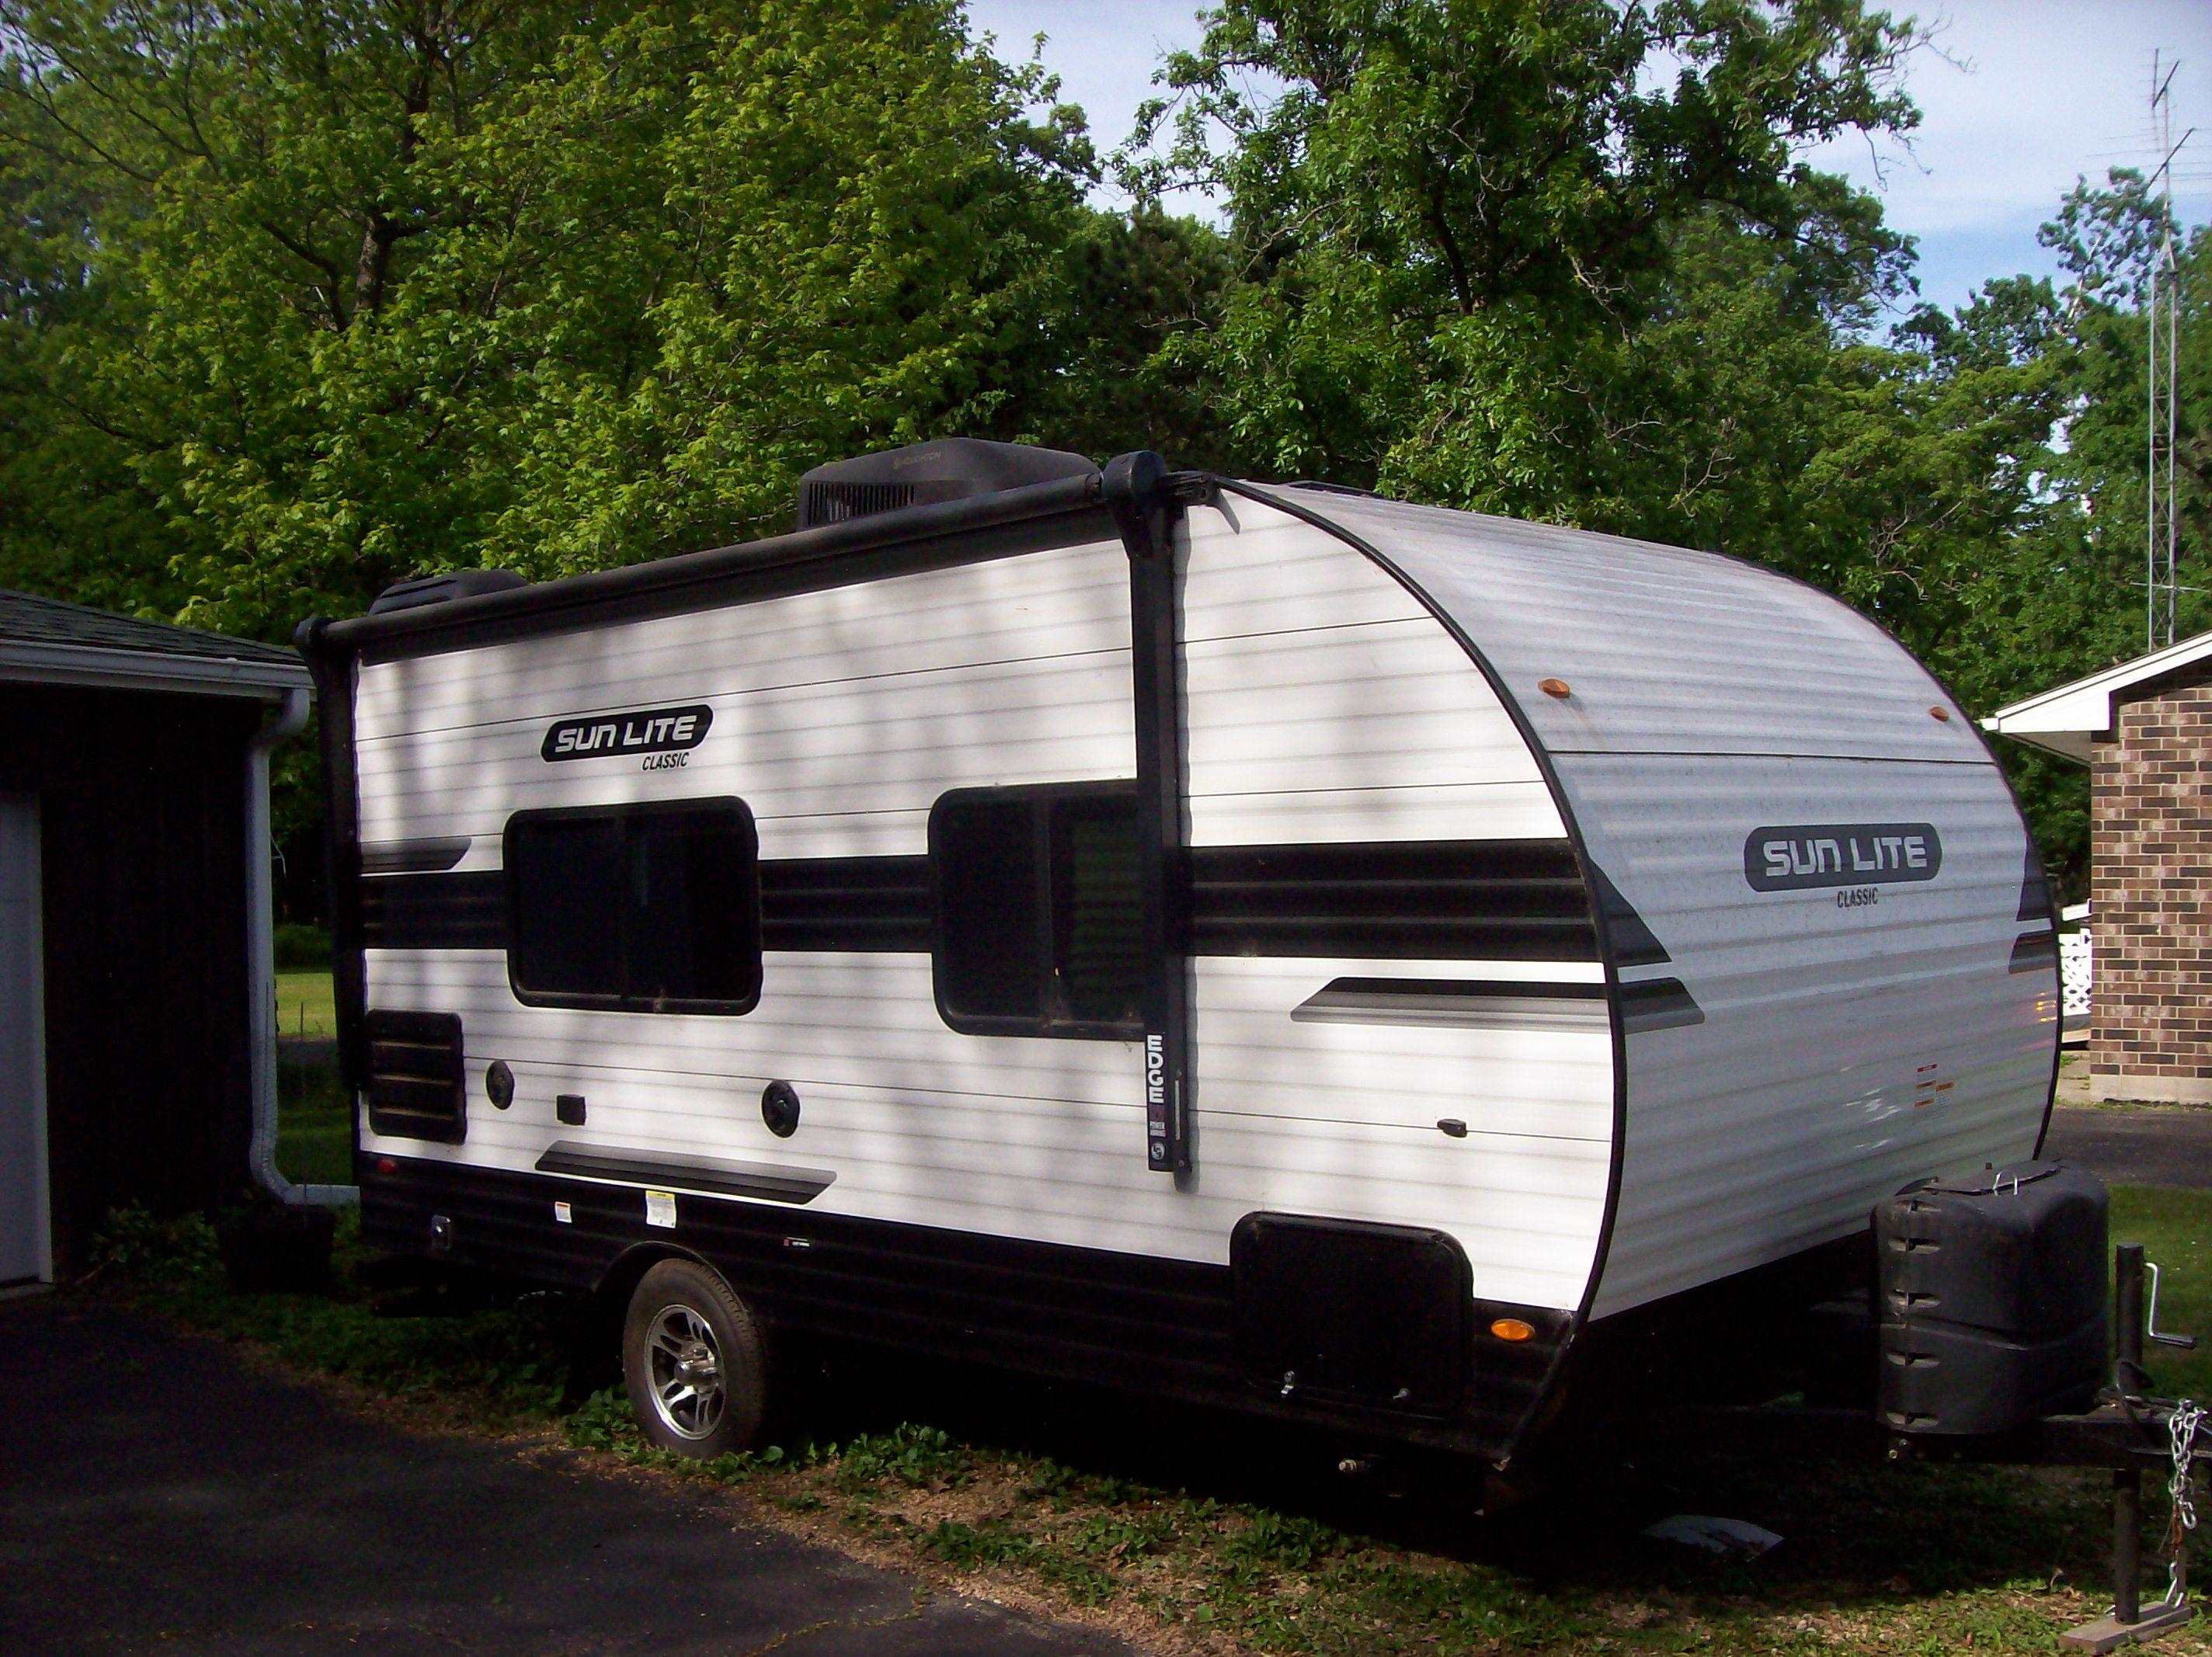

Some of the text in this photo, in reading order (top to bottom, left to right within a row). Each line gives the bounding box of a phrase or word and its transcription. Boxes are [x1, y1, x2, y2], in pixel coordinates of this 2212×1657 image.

[555, 714, 698, 753] SUN LITE
[642, 751, 690, 772] CLASSIC
[1762, 835, 1928, 877] SUN LITE
[1836, 886, 1879, 909] CLASSIC
[1146, 1034, 1165, 1103] EDGE
